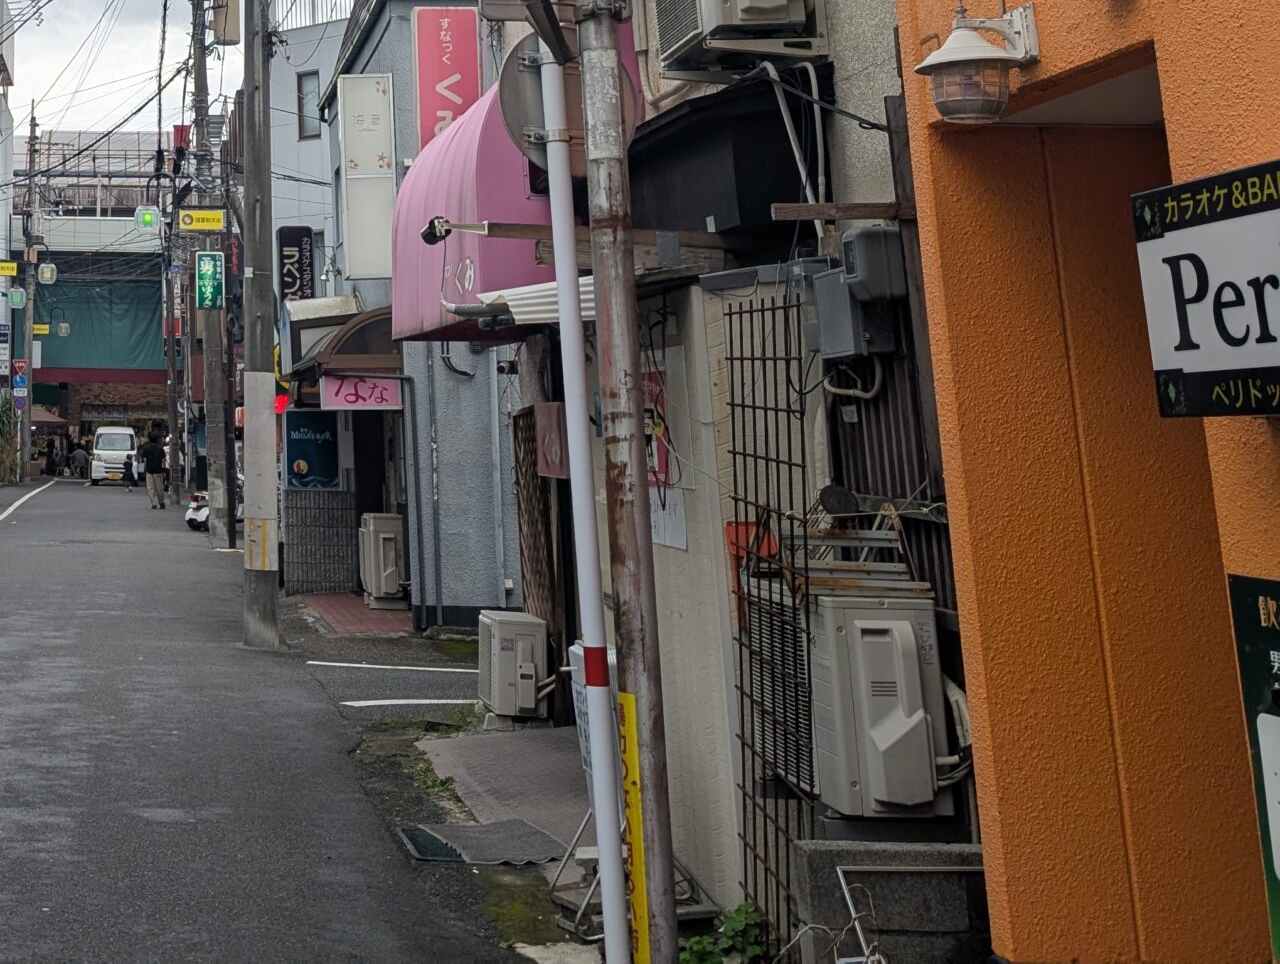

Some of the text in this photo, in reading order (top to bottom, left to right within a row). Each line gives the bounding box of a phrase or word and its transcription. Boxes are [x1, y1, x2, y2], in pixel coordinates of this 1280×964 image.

[439, 17, 453, 65] すなっく
[1163, 170, 1280, 225] カラオケ&BA
[302, 237, 312, 297] カラオケスタジオ
[1258, 595, 1280, 631] 飲
